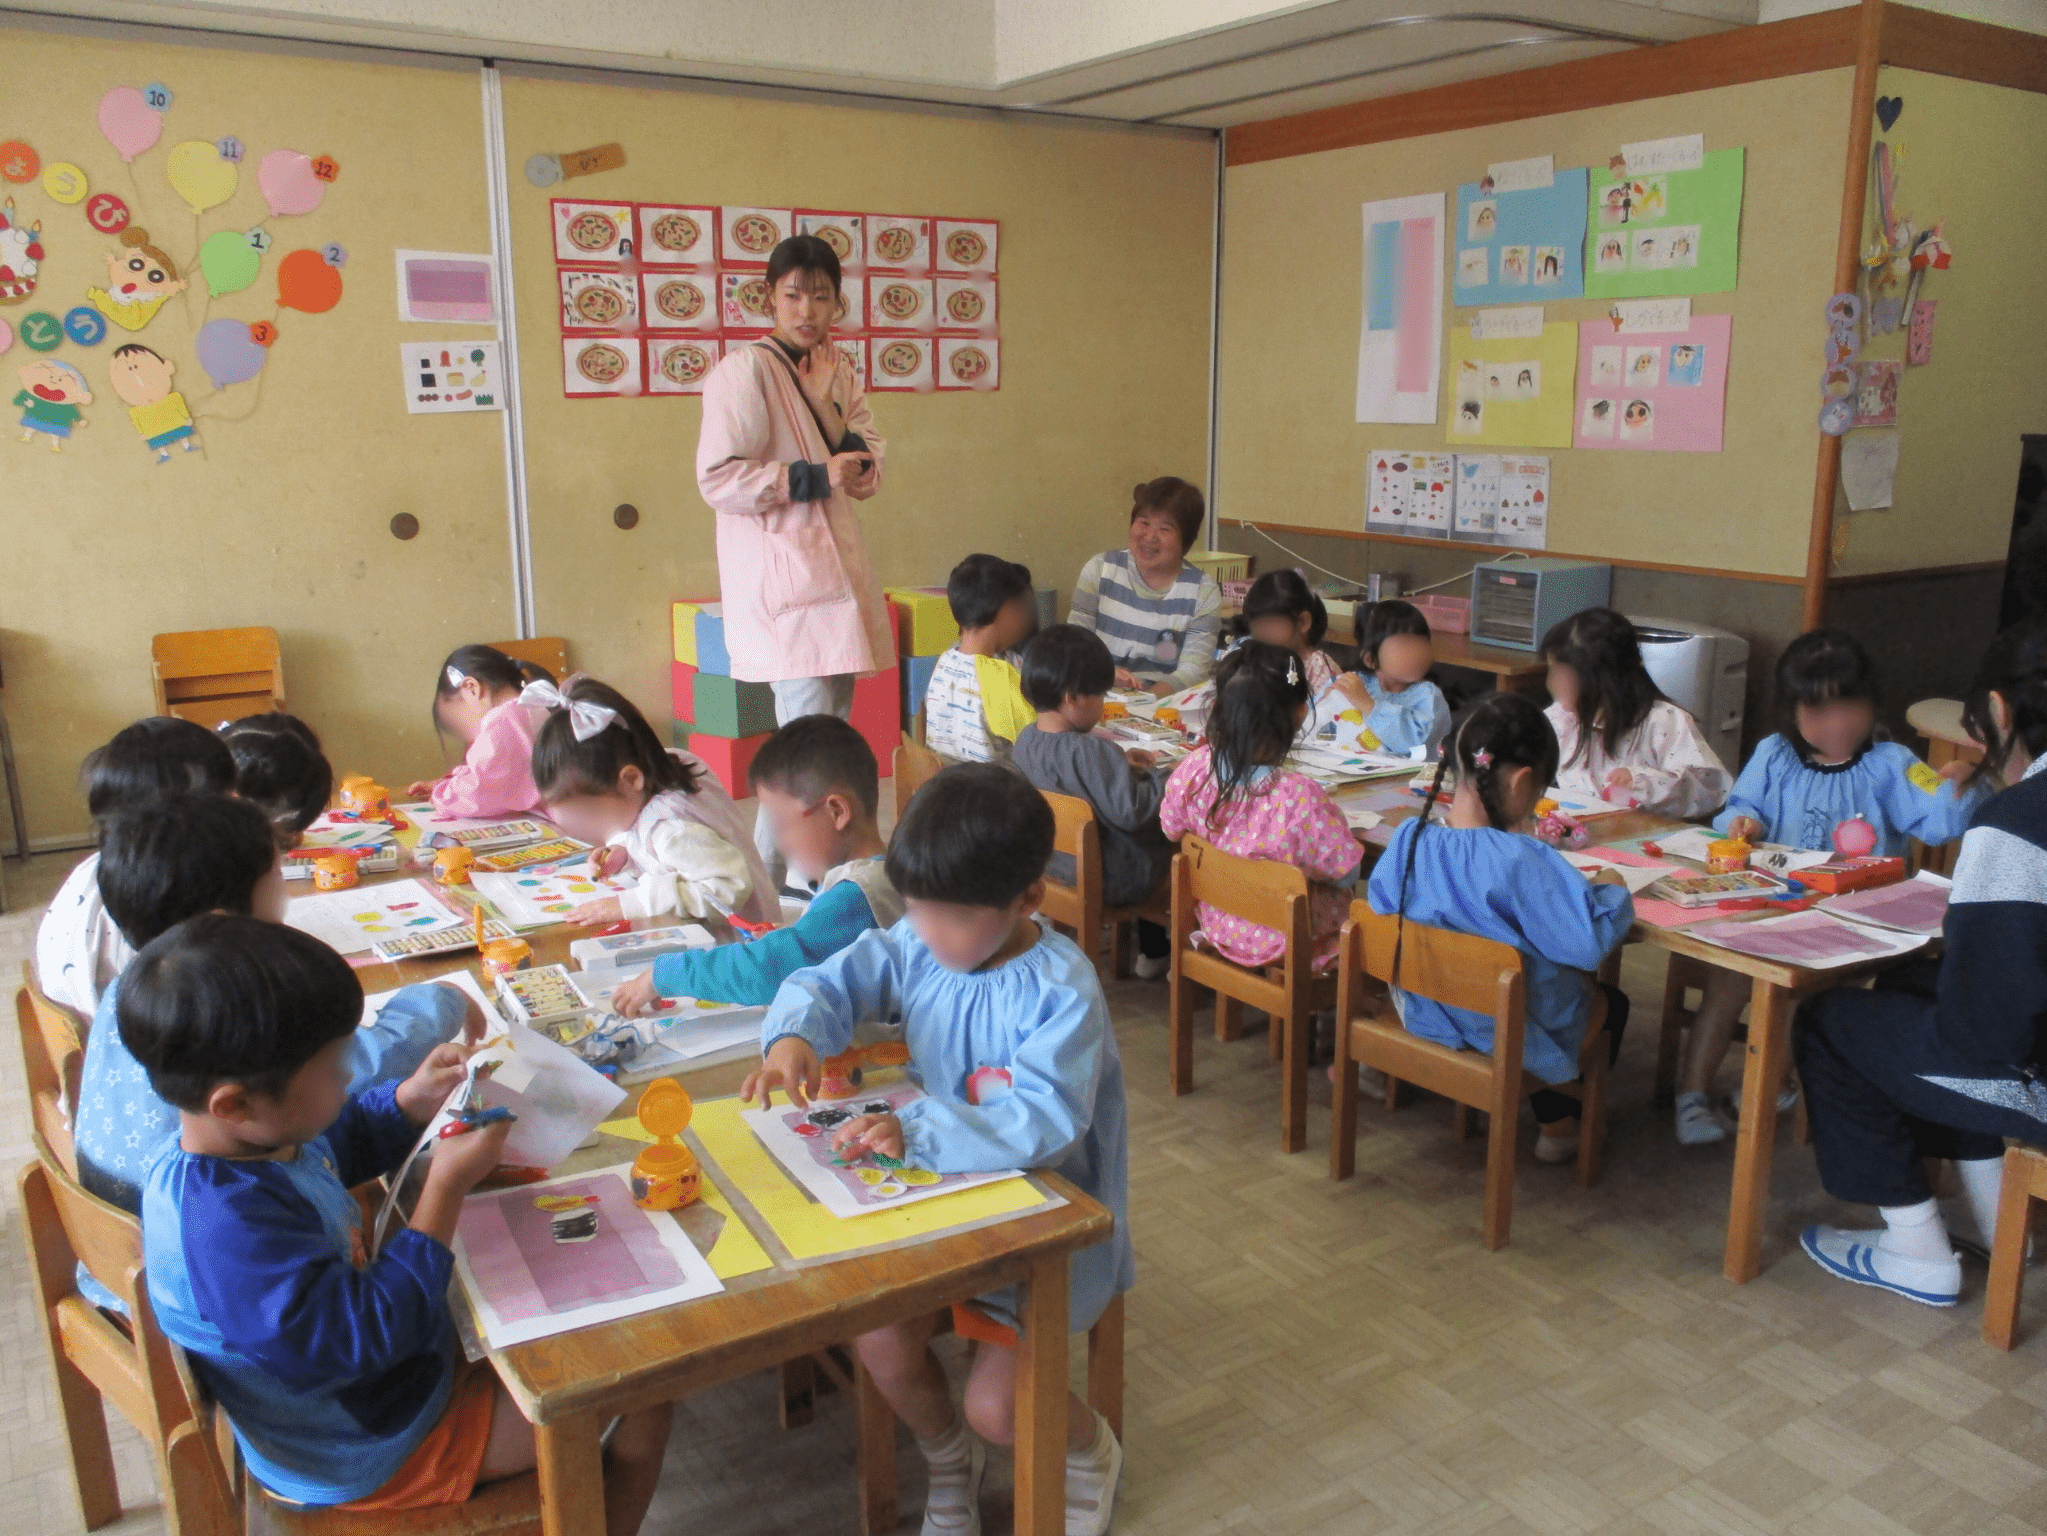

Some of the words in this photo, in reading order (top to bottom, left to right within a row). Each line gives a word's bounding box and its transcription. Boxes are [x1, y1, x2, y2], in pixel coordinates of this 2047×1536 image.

[150, 90, 166, 107] 10
[222, 141, 238, 158] 11
[314, 161, 332, 179] 12
[251, 233, 264, 249] 1
[329, 247, 341, 262] 2
[256, 324, 268, 342] 3
